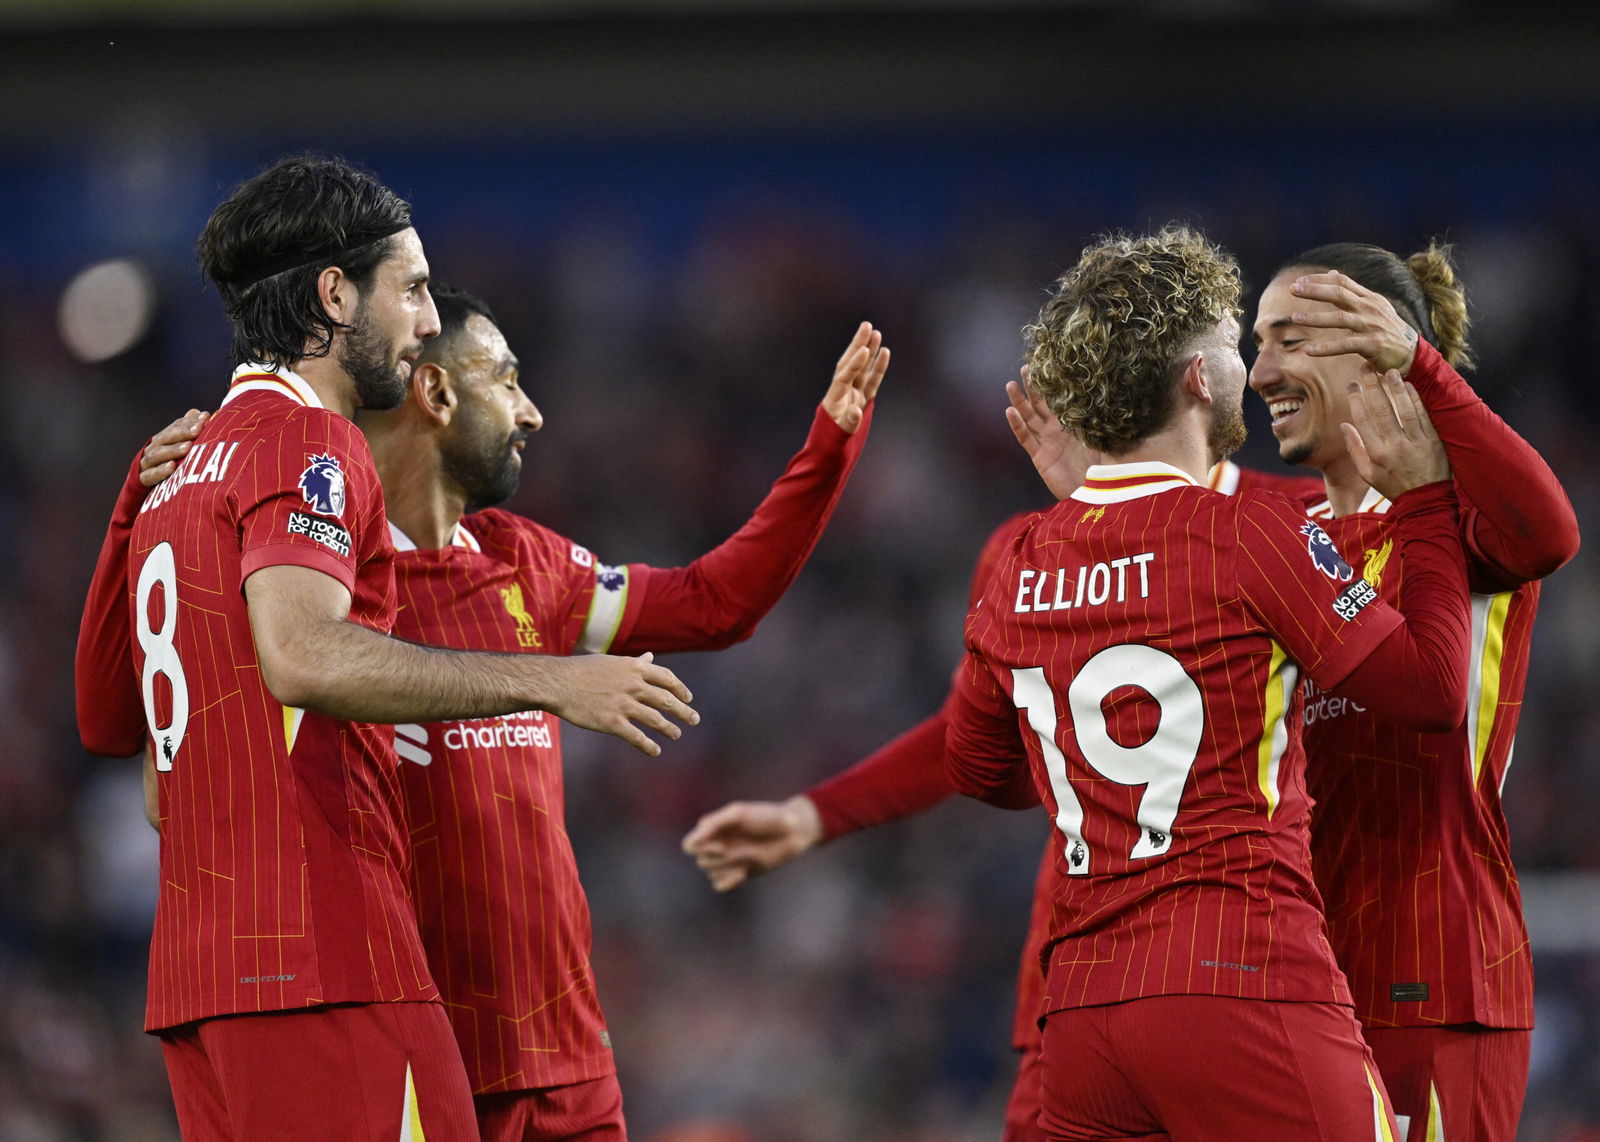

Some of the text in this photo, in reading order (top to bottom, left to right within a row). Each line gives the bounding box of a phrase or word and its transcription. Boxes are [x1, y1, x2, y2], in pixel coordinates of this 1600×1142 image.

[287, 521, 309, 535] for
[289, 512, 348, 544] No room
[1014, 552, 1155, 613] ELLIOTT
[1332, 596, 1352, 615] No
[1339, 603, 1360, 622] for
[516, 632, 543, 647] LFC
[136, 541, 189, 772] 8
[444, 723, 552, 750] chartered
[1010, 643, 1204, 876] 19
